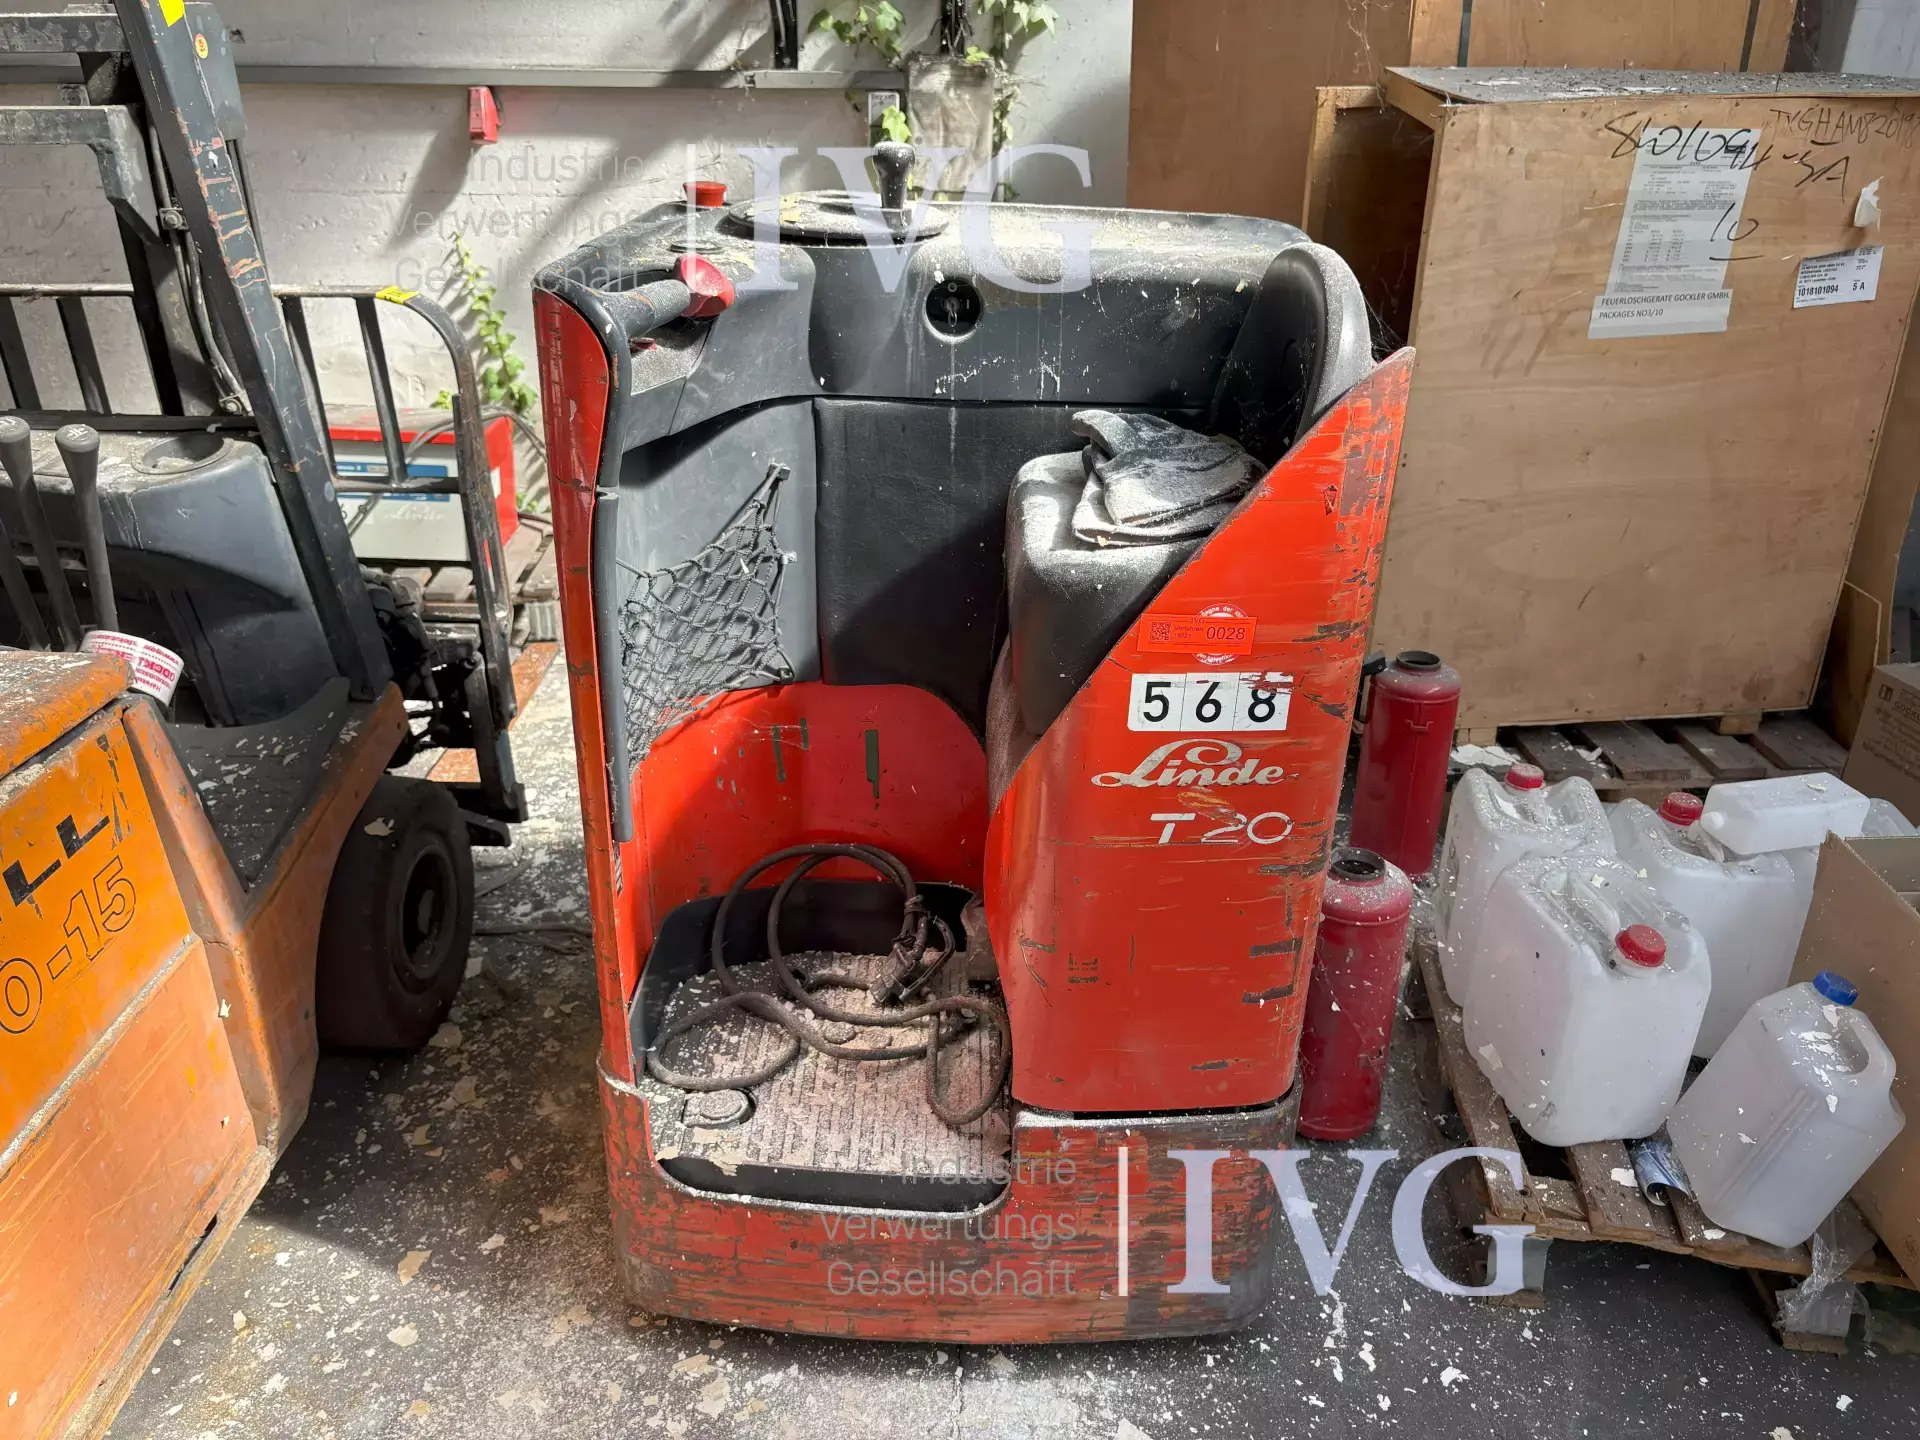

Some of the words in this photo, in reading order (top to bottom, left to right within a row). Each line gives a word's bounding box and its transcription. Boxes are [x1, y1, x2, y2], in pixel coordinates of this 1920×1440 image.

[1797, 284, 1840, 297] 1018101094
[1599, 309, 1635, 320] PACKAGES
[1206, 626, 1246, 640] 0028
[1090, 738, 1288, 788] Linde
[1150, 812, 1196, 844] T
[1200, 812, 1293, 844] 20
[0, 814, 110, 923] LL
